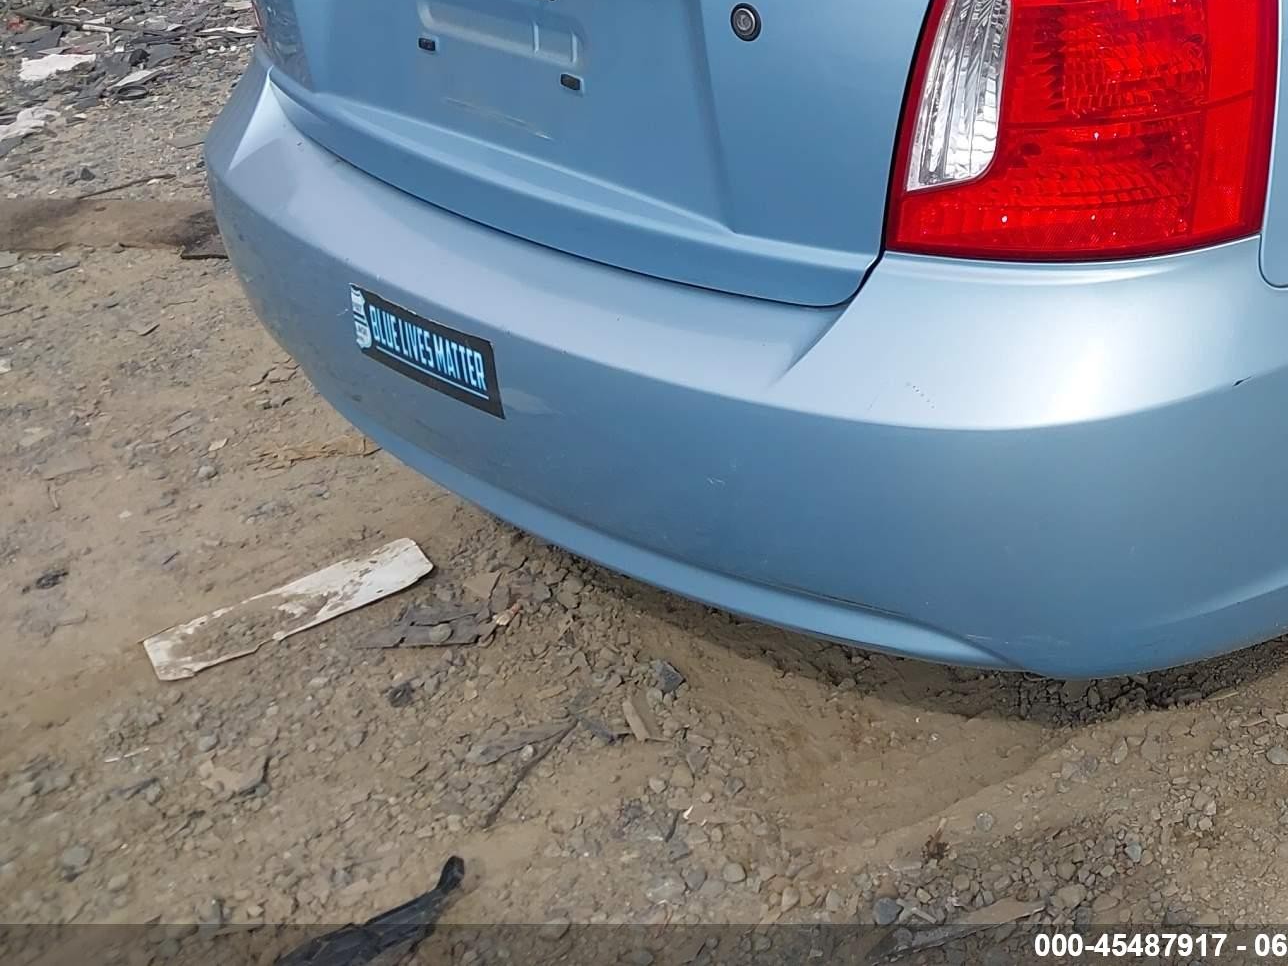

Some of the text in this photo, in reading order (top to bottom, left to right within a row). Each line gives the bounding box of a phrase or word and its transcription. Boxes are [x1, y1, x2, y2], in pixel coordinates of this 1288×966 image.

[368, 304, 488, 392] BLUE LIVES MATTER
